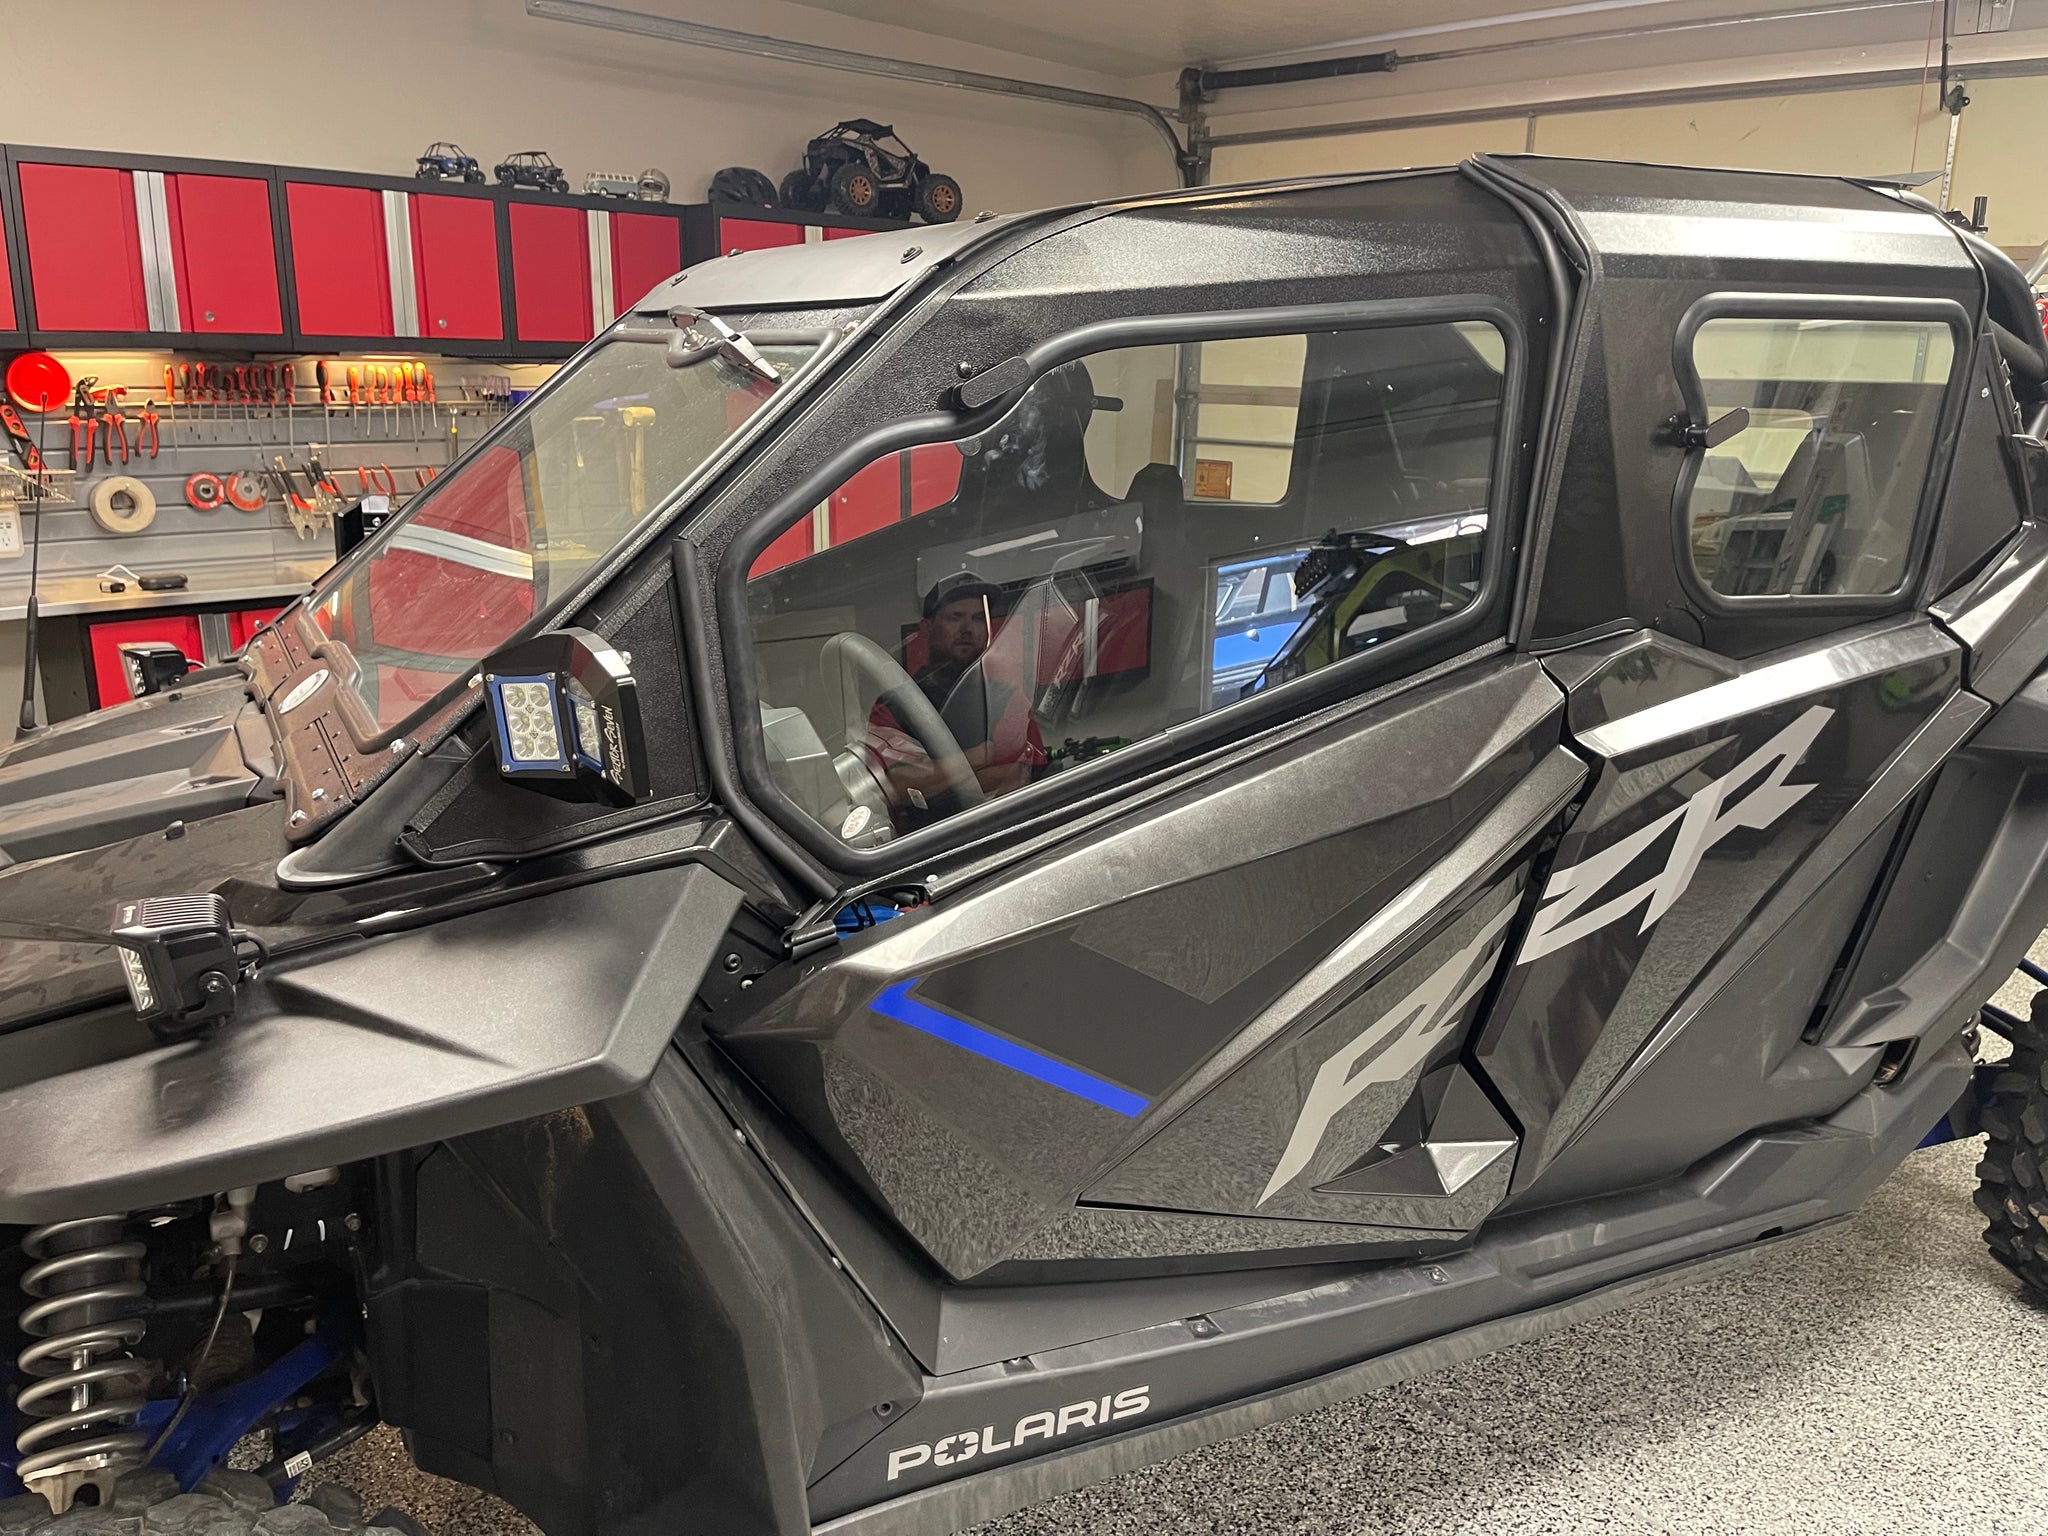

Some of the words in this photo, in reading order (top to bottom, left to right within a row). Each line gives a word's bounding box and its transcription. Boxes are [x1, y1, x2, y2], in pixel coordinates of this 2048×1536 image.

[601, 704, 618, 744] SEVEN
[609, 743, 624, 785] SECTOR
[887, 1385, 1150, 1481] POLARIS
